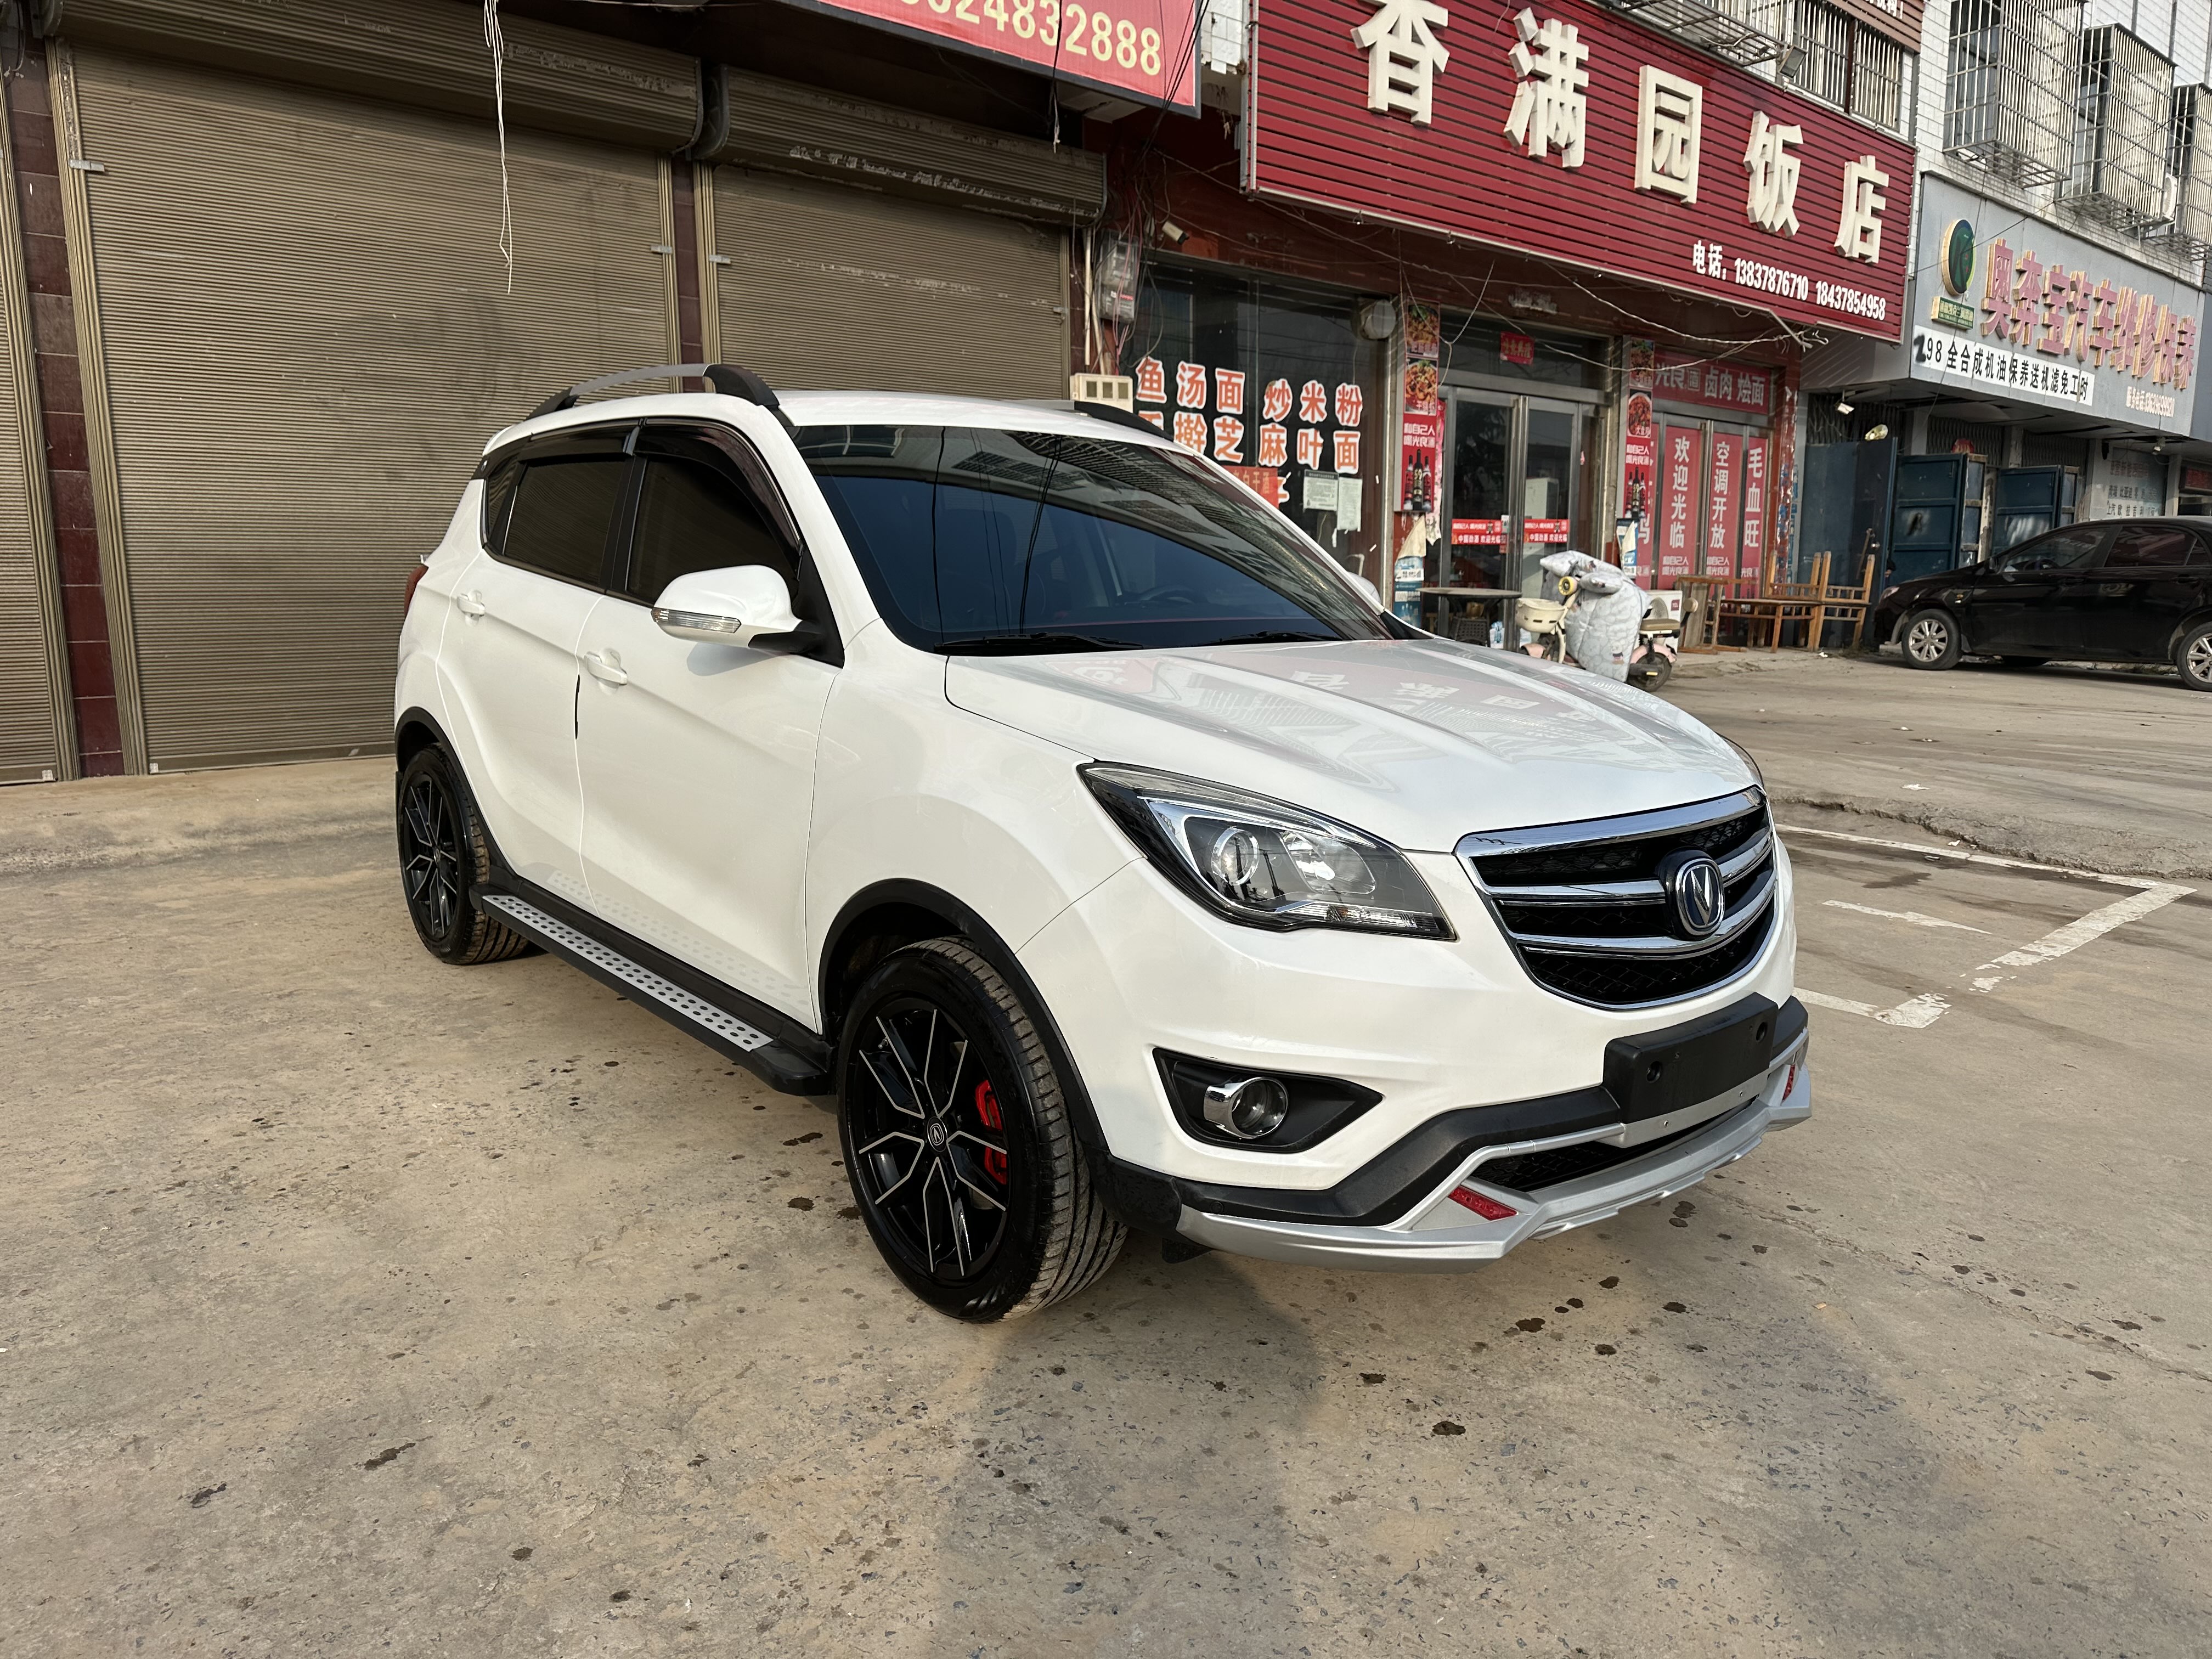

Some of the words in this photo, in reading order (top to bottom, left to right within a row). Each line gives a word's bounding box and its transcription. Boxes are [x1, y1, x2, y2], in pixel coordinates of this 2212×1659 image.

[900, 0, 1161, 76] 4832888
[1350, 0, 1889, 264] 香满园饭店
[1692, 240, 1727, 281] 电话：
[1734, 257, 1809, 301] 13837876710
[1815, 280, 1887, 320] 18437854958
[1136, 357, 1245, 414] 鱼汤面
[1263, 378, 1363, 426] 炒米粉
[1705, 365, 1733, 400] 卤肉
[1736, 373, 1765, 406] 烩面
[1669, 436, 1690, 548] 欢迎光临
[1711, 441, 1729, 549] 空调开放
[1745, 447, 1763, 548] 毛血旺
